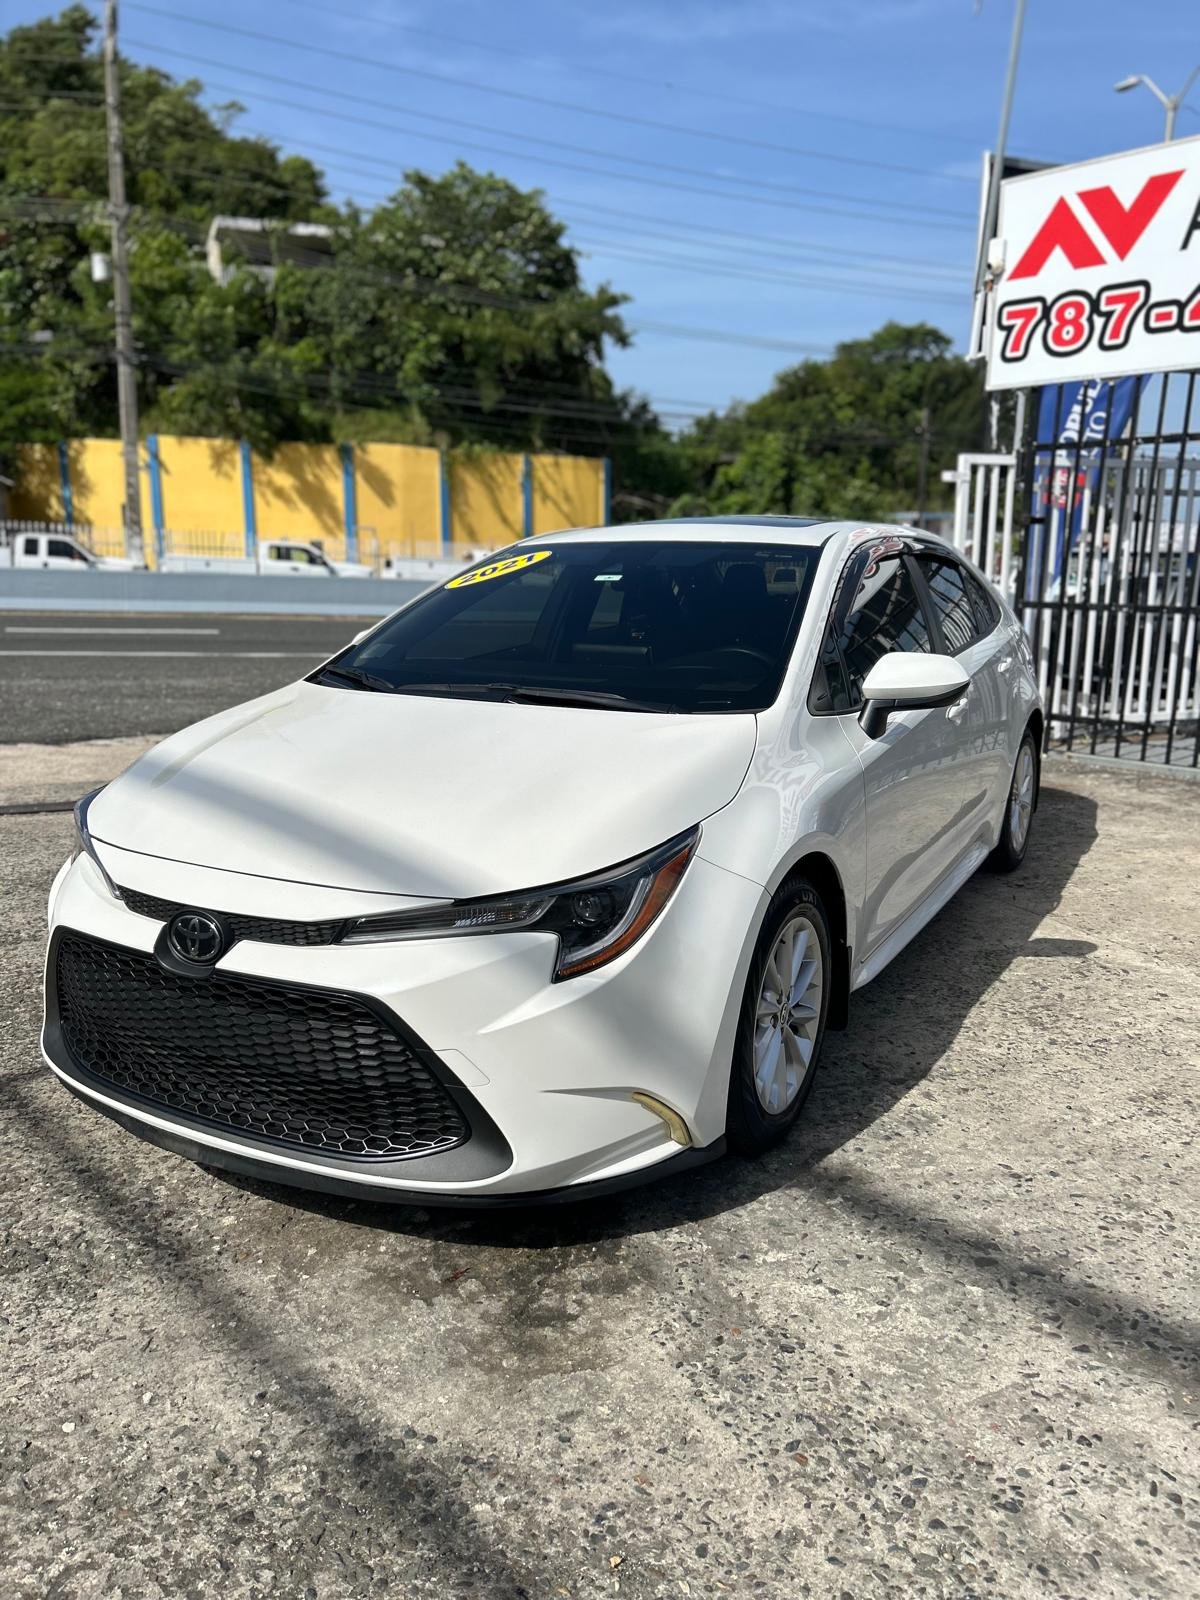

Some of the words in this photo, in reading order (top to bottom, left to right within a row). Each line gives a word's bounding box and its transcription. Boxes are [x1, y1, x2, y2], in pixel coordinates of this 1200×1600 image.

[1007, 169, 1186, 281] AV
[1054, 378, 1102, 467] POPUL
[460, 555, 536, 585] 2021
